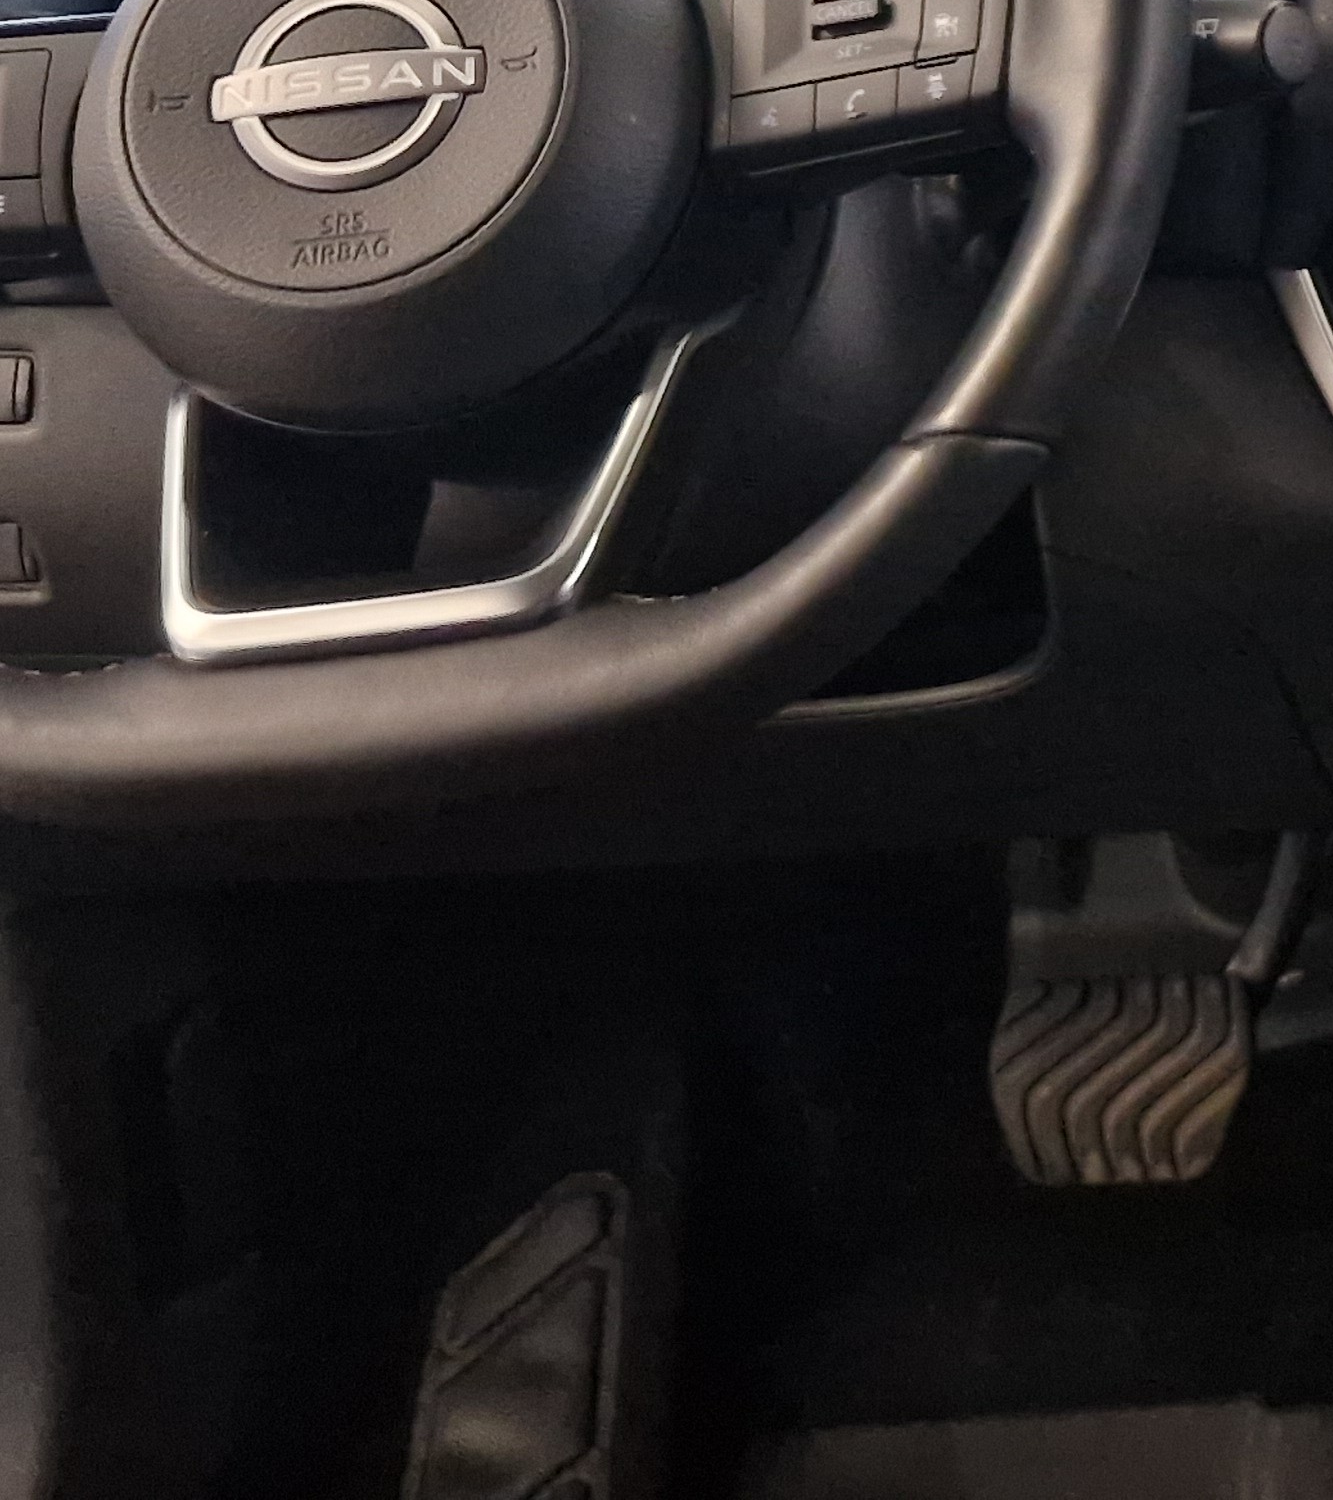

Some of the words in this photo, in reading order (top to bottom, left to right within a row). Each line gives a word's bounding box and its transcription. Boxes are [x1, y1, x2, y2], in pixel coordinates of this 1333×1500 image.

[217, 56, 477, 112] NISSAN
[321, 210, 366, 235] SRS
[291, 238, 392, 268] AIRBAG
